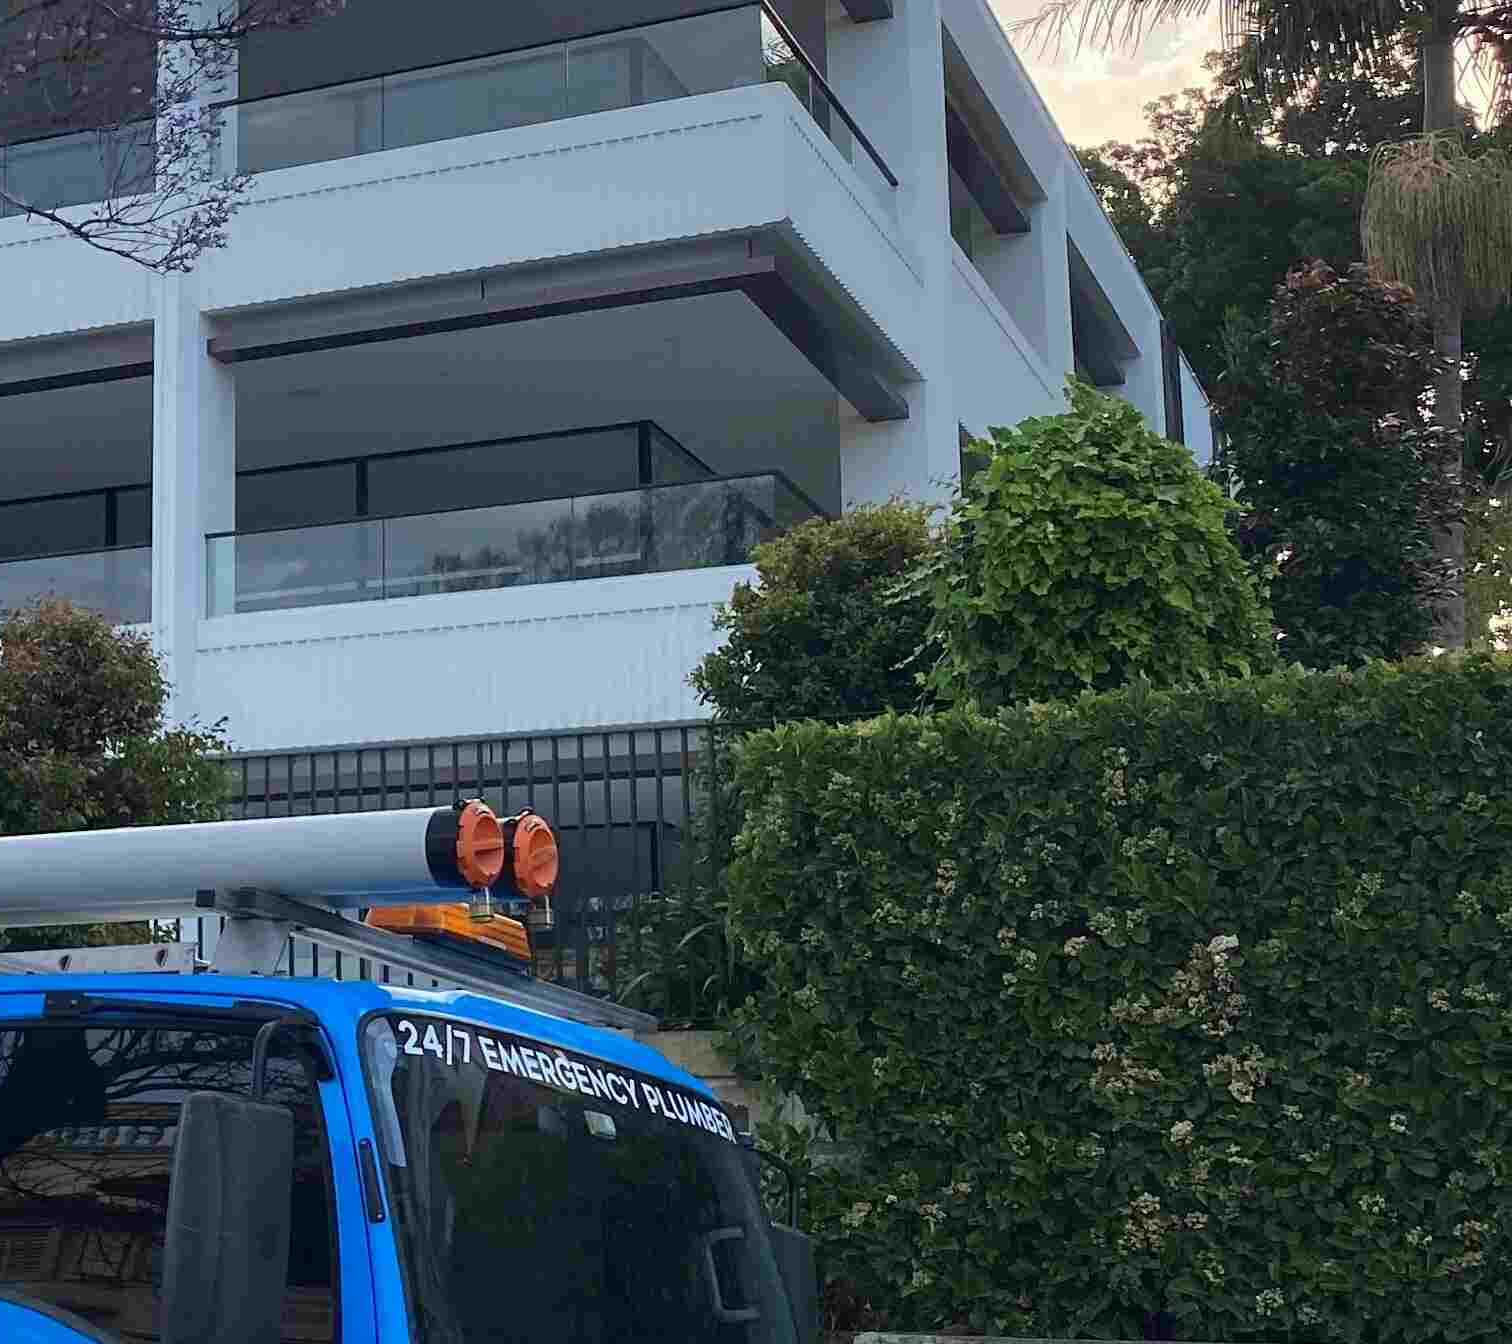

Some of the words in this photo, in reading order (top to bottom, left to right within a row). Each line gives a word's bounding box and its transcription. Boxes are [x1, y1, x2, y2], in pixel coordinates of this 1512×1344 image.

[398, 1020, 470, 1064] 24/7
[479, 1035, 639, 1108] EMERGENCY
[641, 1082, 737, 1144] PLUMBER
